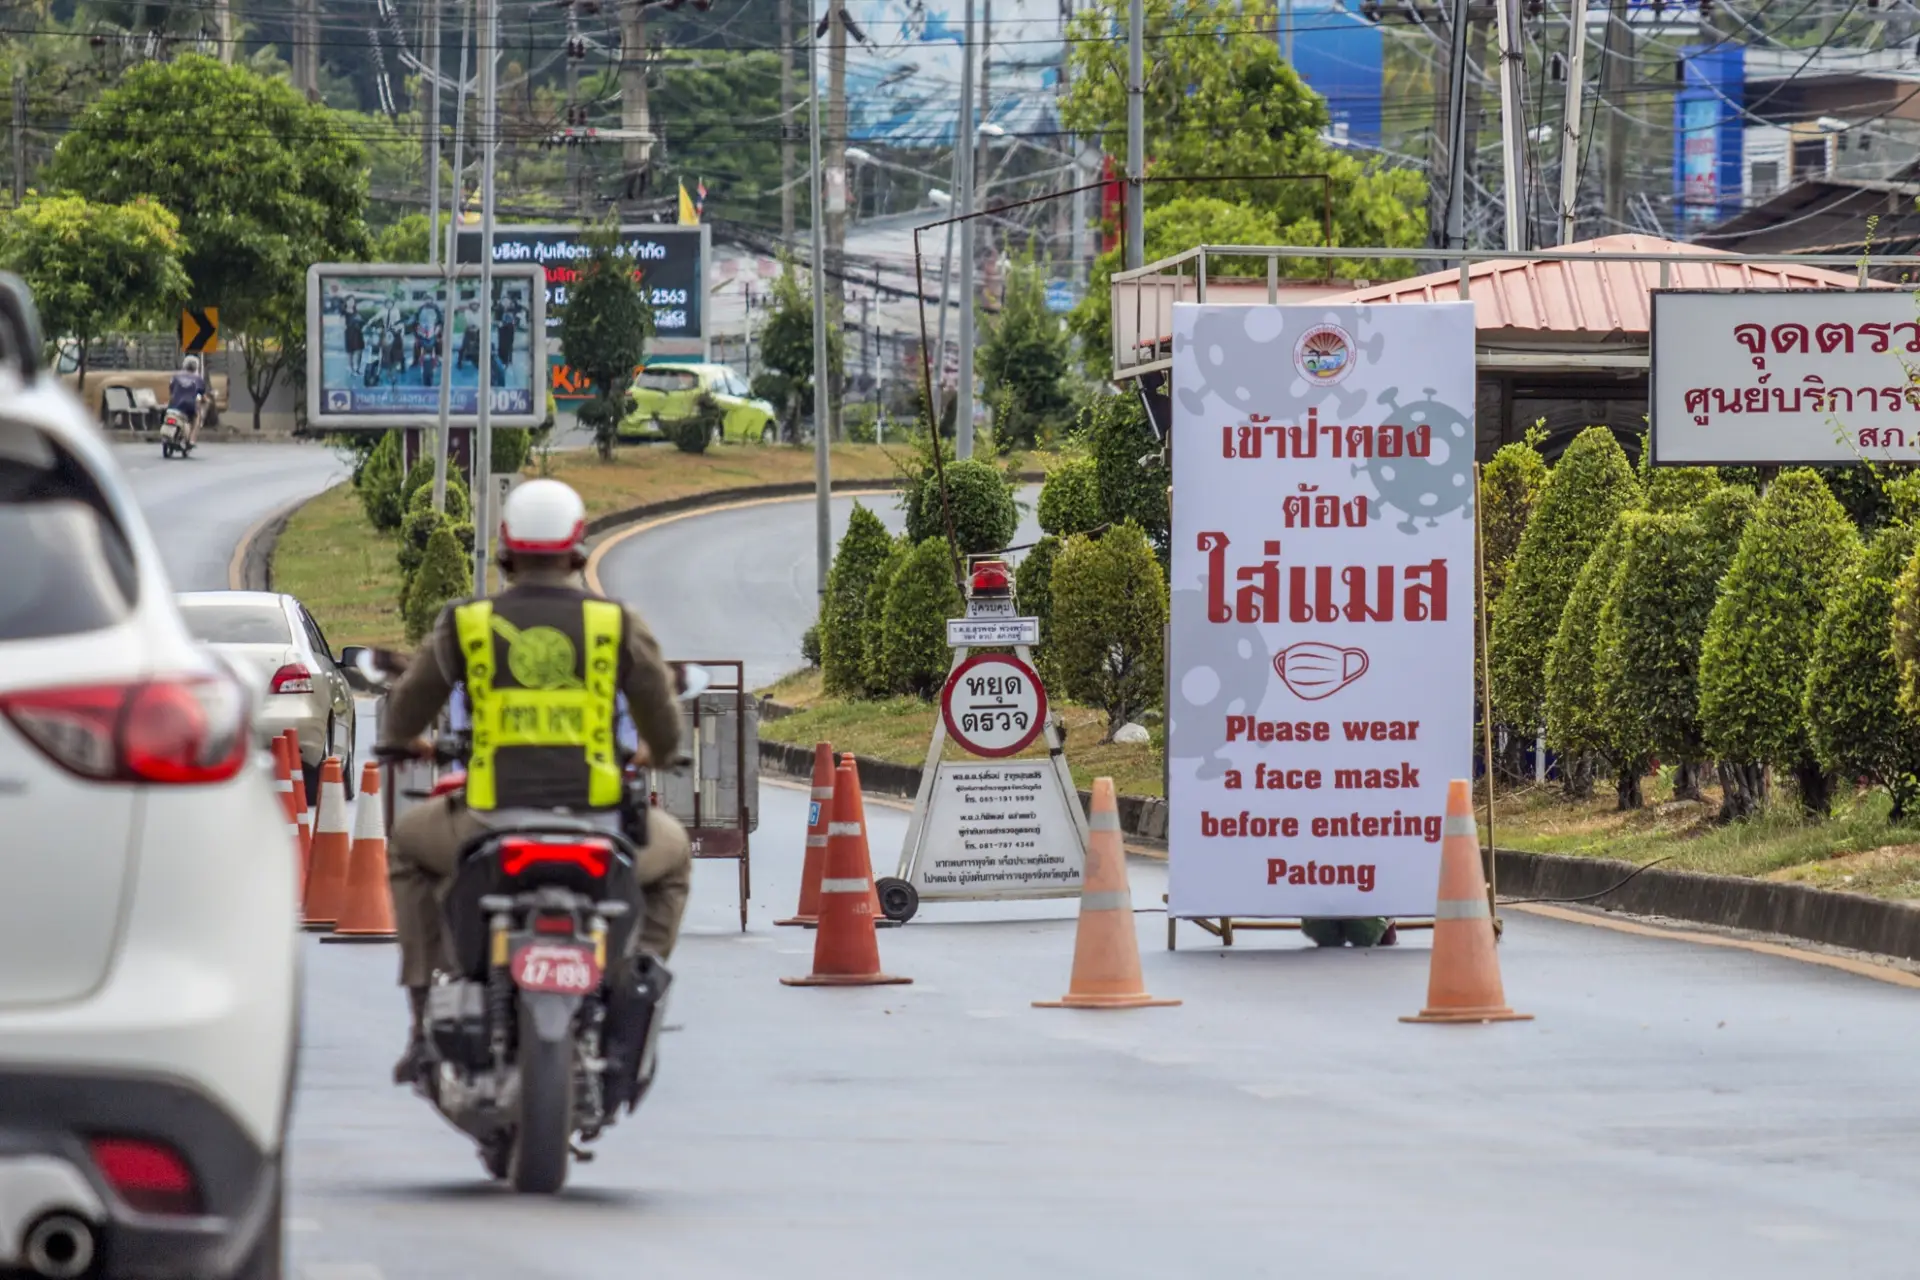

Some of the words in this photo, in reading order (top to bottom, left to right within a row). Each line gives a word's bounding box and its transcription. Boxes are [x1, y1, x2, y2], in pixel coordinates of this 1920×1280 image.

[652, 289, 687, 304] 2563
[475, 390, 527, 411] 00%
[1223, 407, 1431, 459] เข้าป่าตอง
[1282, 483, 1367, 528] ต้อง
[1196, 531, 1448, 623] ใส่แมส
[966, 675, 1022, 704] หยุด
[961, 711, 1029, 733] ตรวจ
[1226, 715, 1330, 742] Please
[1343, 720, 1420, 741] wear
[1224, 768, 1242, 789] a
[1255, 763, 1322, 789] face
[1334, 763, 1420, 789] mask
[1201, 811, 1299, 837] before
[1311, 810, 1442, 843] entering
[1267, 858, 1376, 892] Patong
